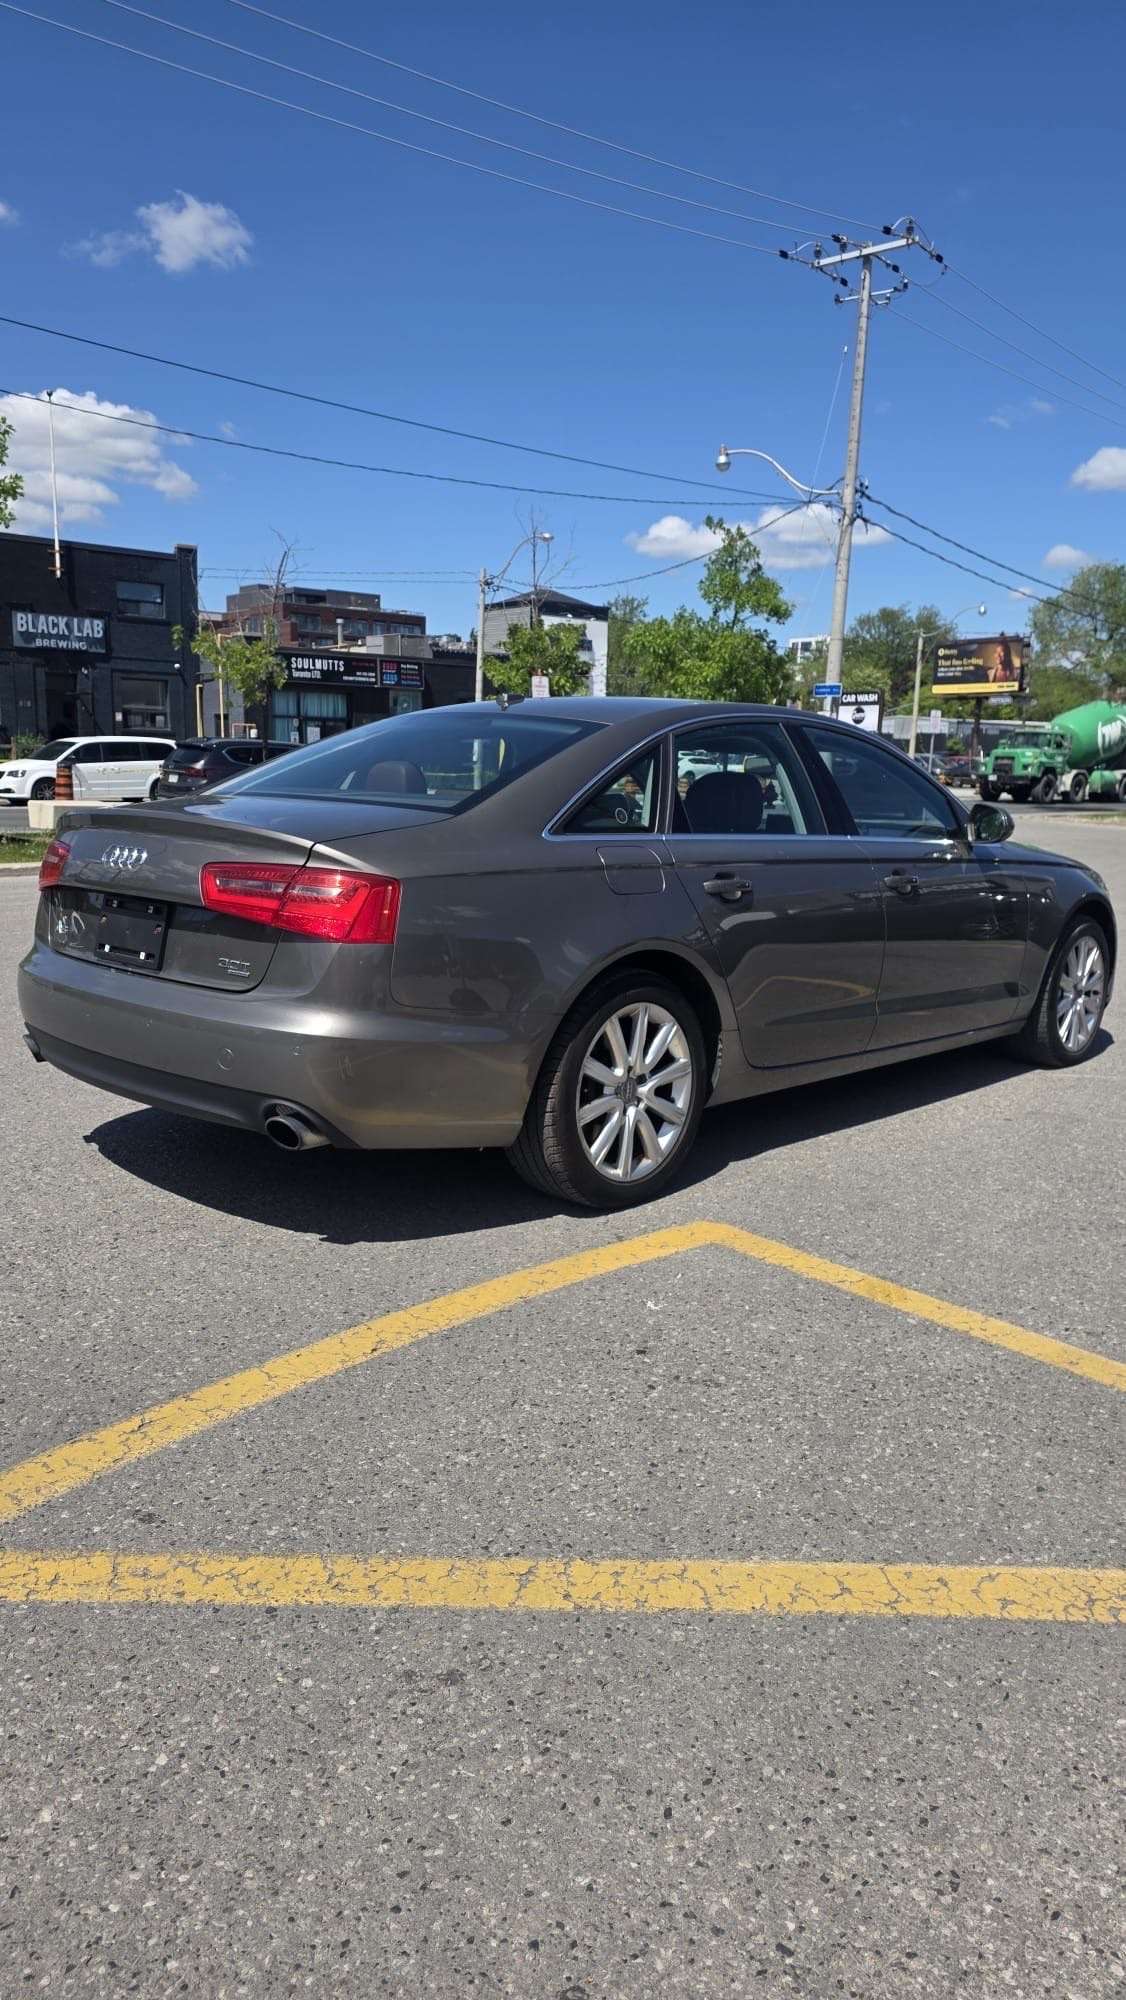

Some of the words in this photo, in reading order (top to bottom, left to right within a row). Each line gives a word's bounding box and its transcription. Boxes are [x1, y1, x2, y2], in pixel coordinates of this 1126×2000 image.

[16, 612, 69, 636] BLACK
[73, 617, 103, 638] LAB
[35, 638, 87, 650] BREWING
[291, 656, 345, 672] SOULMUTTS
[842, 694, 857, 703] CAR
[858, 693, 878, 703] WASH
